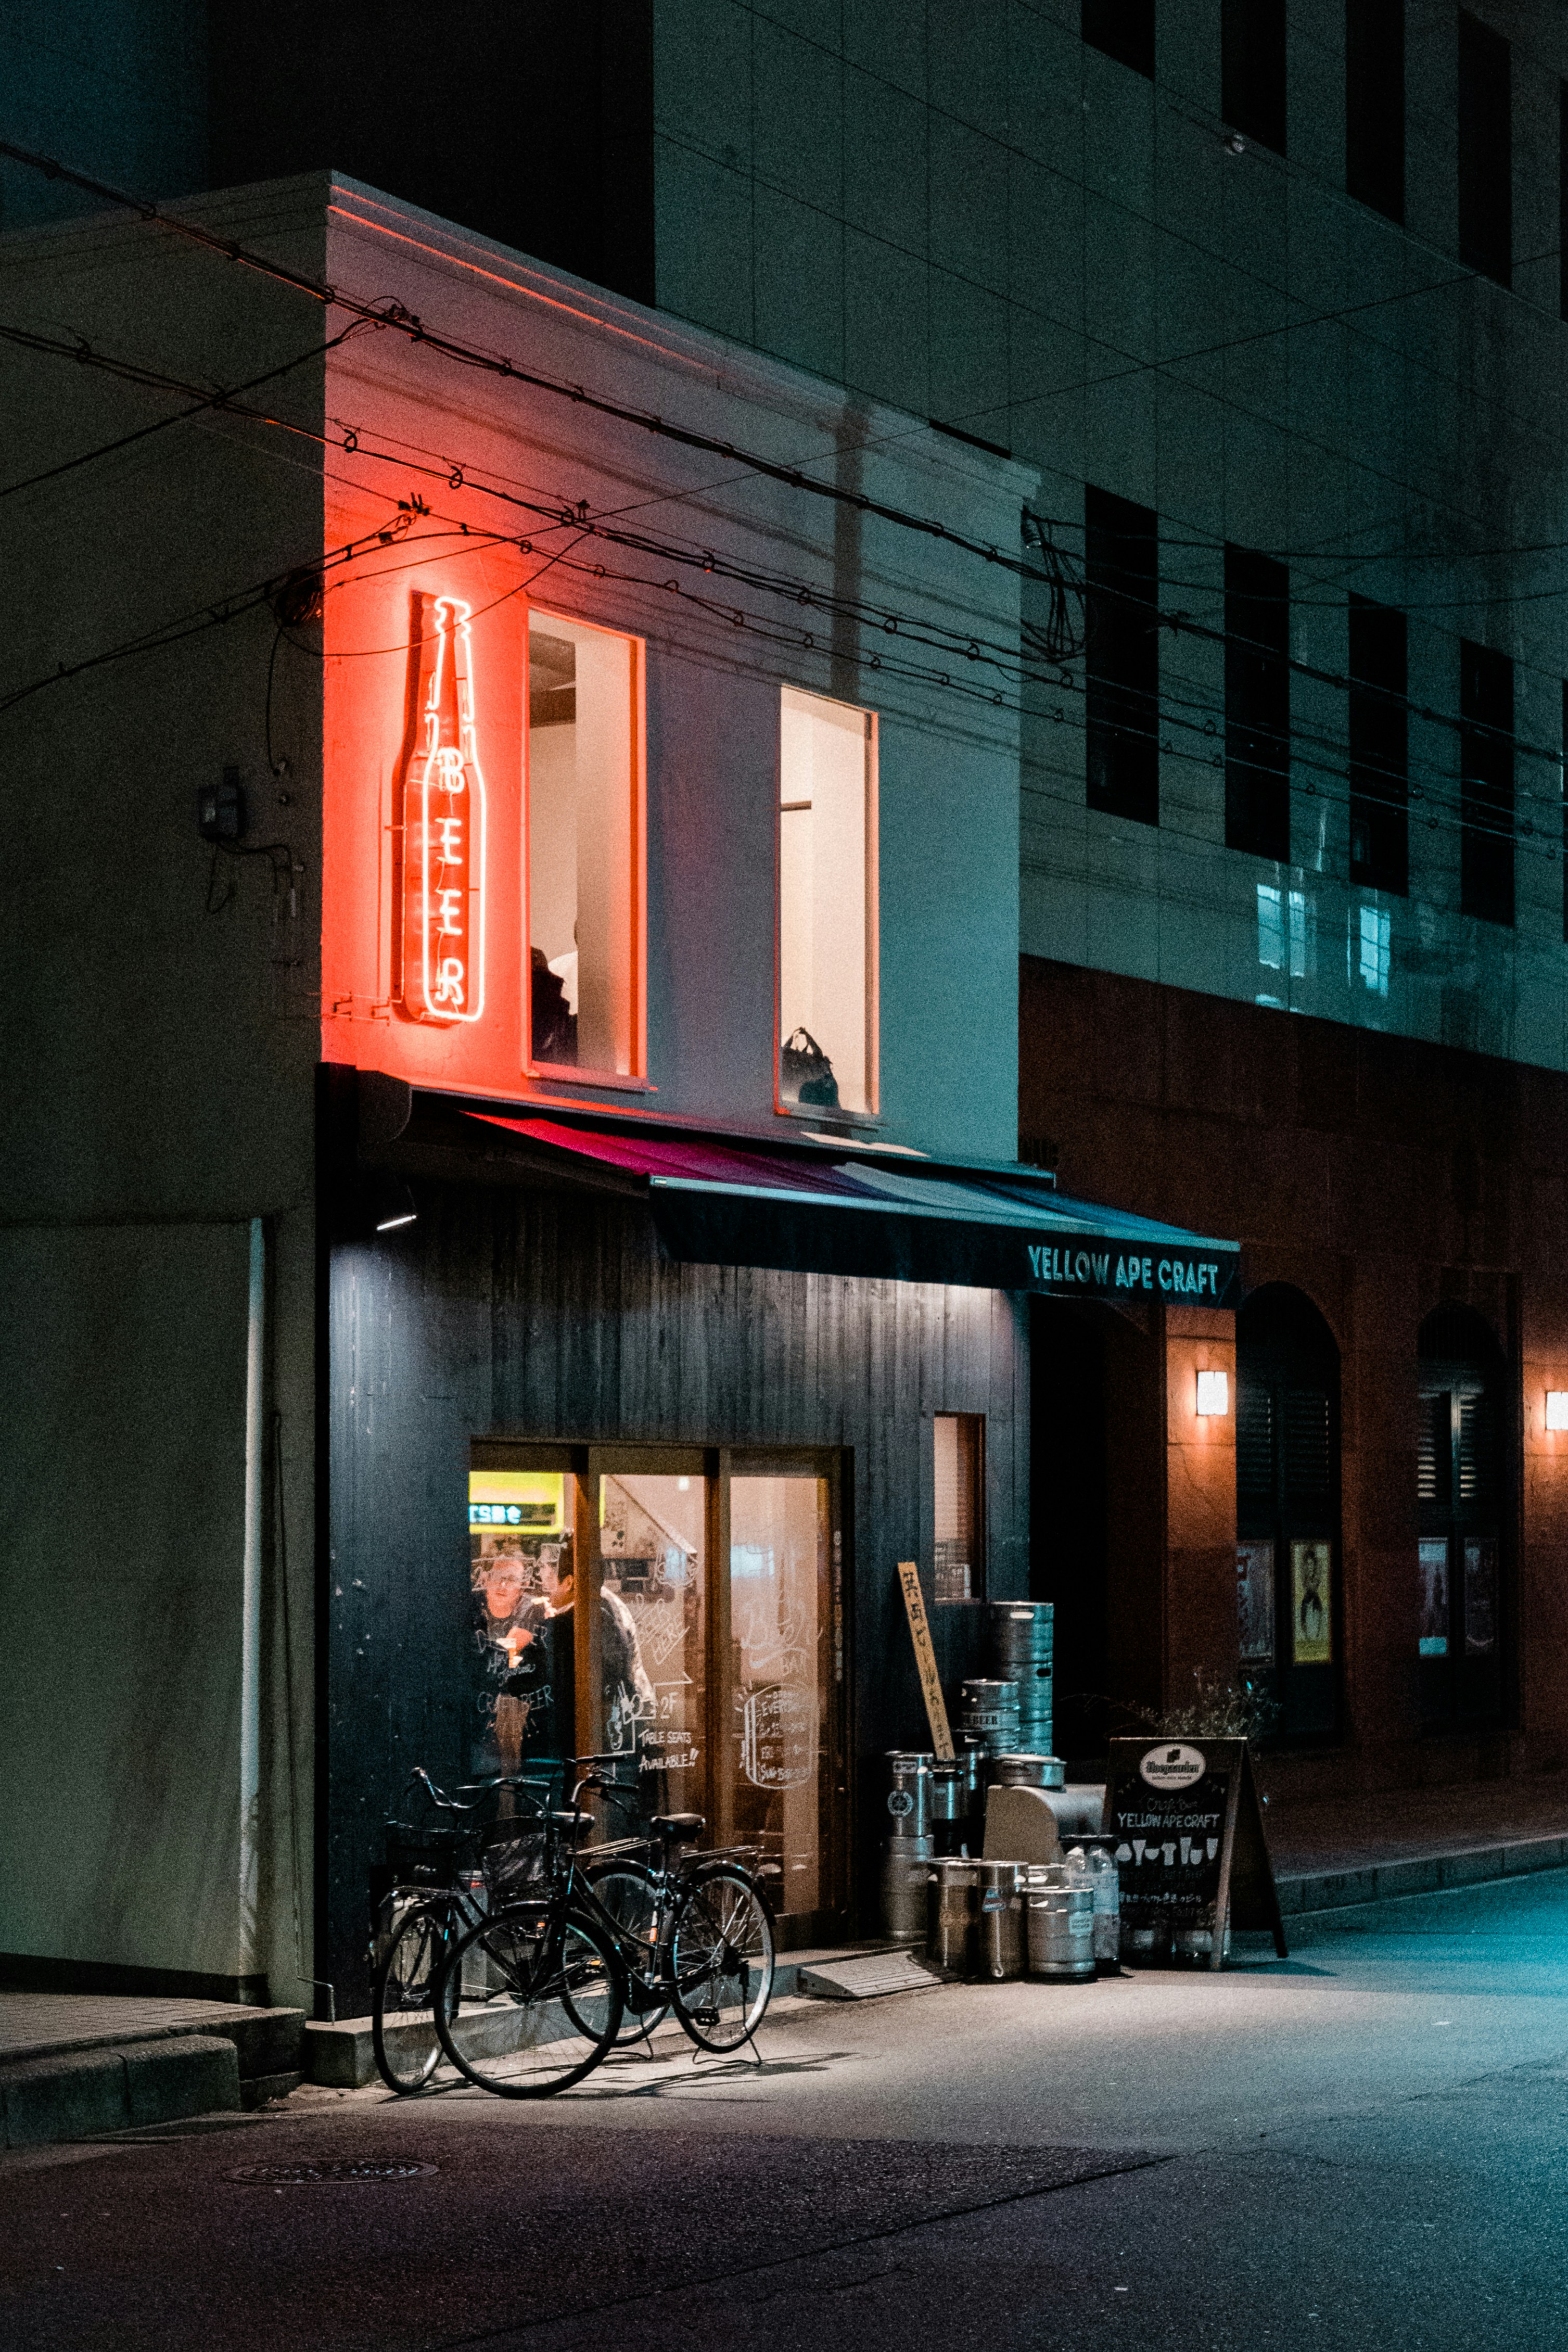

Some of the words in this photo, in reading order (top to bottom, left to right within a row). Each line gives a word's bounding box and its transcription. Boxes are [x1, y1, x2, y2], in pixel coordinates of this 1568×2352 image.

[435, 745, 464, 1004] BEER
[1028, 1245, 1109, 1285] YELLOW
[1116, 1255, 1153, 1289] APE
[1158, 1260, 1218, 1294] CRAFT
[660, 1692, 678, 1719] 2F
[638, 1728, 666, 1747] TABLE
[667, 1731, 692, 1744] SEATS
[639, 1748, 700, 1773] AVAILABLE!!
[1117, 1812, 1161, 1828] YELLOW
[1162, 1814, 1184, 1828] APE
[1184, 1813, 1220, 1828] CRAFT
